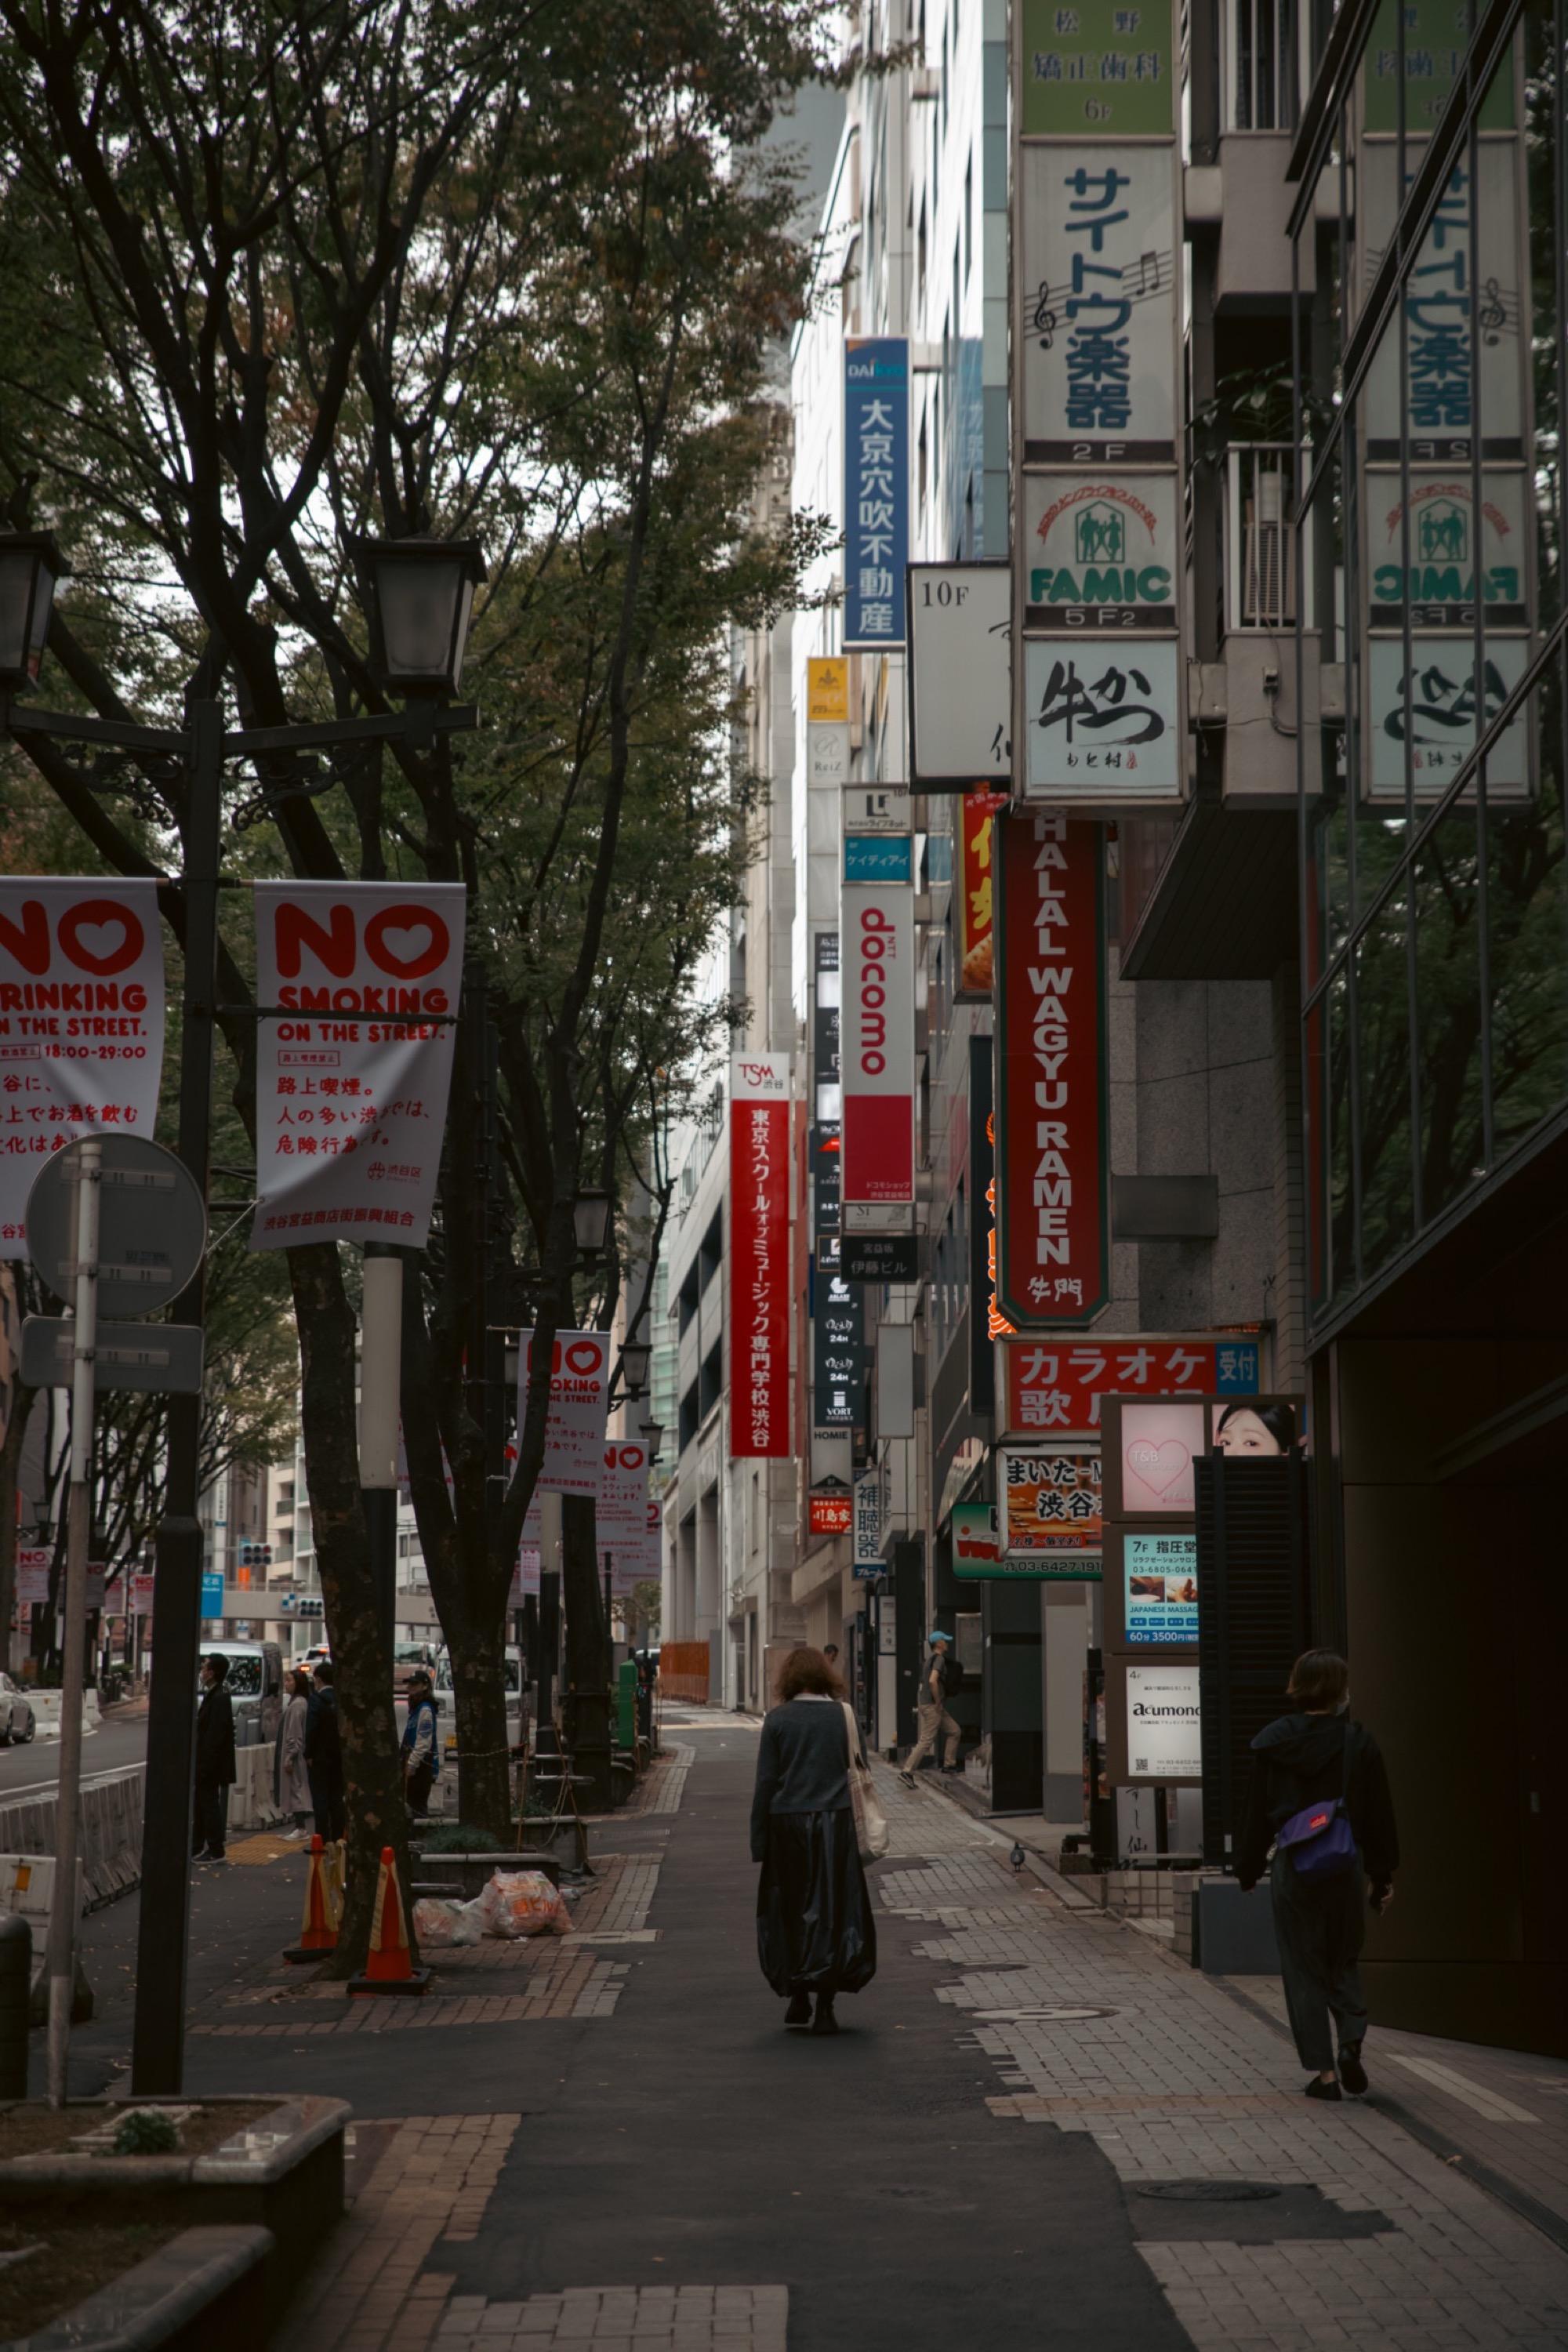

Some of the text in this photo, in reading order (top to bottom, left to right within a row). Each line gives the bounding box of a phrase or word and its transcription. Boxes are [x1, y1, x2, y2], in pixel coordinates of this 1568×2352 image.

[1034, 53, 1161, 80] 矯正歯科
[1085, 100, 1111, 119] 6F
[1065, 168, 1131, 429] サイトウ楽器
[858, 399, 895, 635] 大京穴吹不動産
[922, 581, 970, 607] 10F
[1030, 564, 1171, 604] FAMIC
[1038, 660, 1165, 746] 牛かつ
[848, 854, 908, 866] ケイティアイ
[0, 898, 145, 977] NO
[275, 902, 450, 980] NO
[887, 936, 896, 959] NTT
[0, 982, 147, 1013] RINKING
[277, 985, 449, 1014] SMOKING
[861, 908, 896, 1075] docomo
[18, 1018, 60, 1036] THE
[67, 1017, 147, 1036] STREET.
[278, 1022, 445, 1042] ON THE STREET.
[0, 1047, 37, 1057] 飲酒禁止
[45, 1044, 147, 1060] 18:00-29:00
[1026, 815, 1075, 1265] HALAL WAGYU RAMEN
[3, 1074, 52, 1092] 谷に、
[277, 1077, 373, 1096] 路上喫煙。
[738, 1064, 775, 1086] TSM
[763, 1079, 784, 1090] 渋谷
[0, 1103, 138, 1123] 上でお酒を飲む
[263, 1208, 416, 1231] 渋谷宮益商店街振興組合
[750, 1108, 771, 1449] 東京スクールオブミュージック専門学校渋谷
[1027, 1275, 1083, 1306] 牛門
[1020, 1347, 1206, 1386] カラオケ
[1218, 1349, 1255, 1381] 受付
[814, 1432, 848, 1440] HOMIE
[813, 1508, 852, 1523] 川島家
[1038, 1492, 1102, 1519] 渋谷
[858, 1484, 879, 1559] 補聴器
[20, 1552, 46, 1563] NO
[1132, 1540, 1197, 1554] 7F 指圧堂
